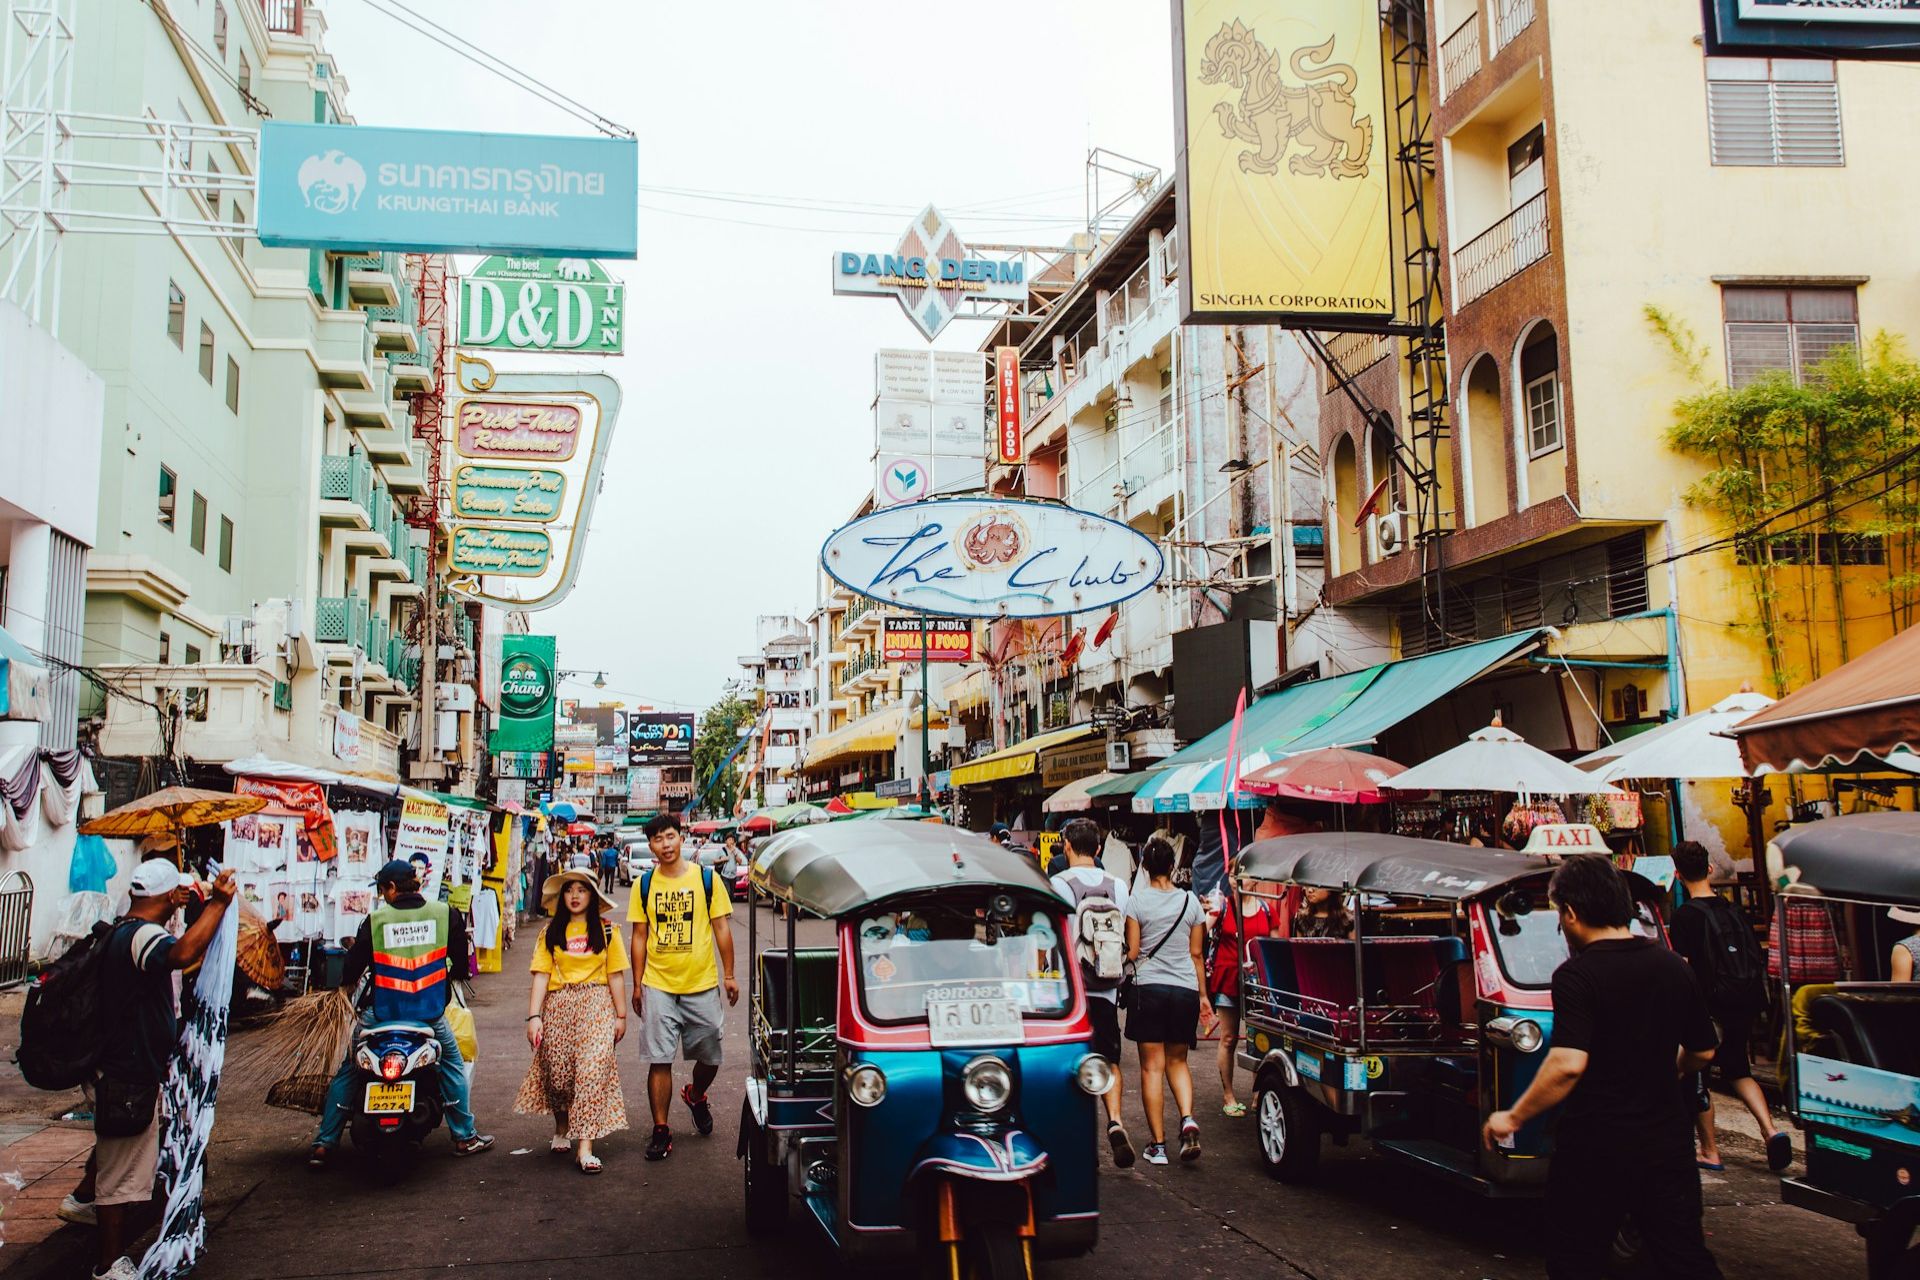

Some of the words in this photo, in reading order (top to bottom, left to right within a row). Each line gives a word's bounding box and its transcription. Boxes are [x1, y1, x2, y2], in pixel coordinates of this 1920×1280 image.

[378, 162, 605, 199] ธนาคารกรุงไทย
[377, 194, 498, 215] KRUNGTHAI
[504, 199, 559, 217] BANK
[506, 257, 521, 270] The
[522, 257, 540, 271] best
[841, 252, 926, 278] DANG
[941, 258, 1024, 283] DERM
[878, 275, 929, 288] Authentic
[934, 280, 956, 290] Thai
[959, 281, 988, 291] Hotel
[1200, 293, 1265, 306] SINGHA
[1269, 294, 1387, 310] CORPORATION
[464, 280, 593, 348] D&D
[601, 286, 619, 346] INN
[1004, 361, 1014, 413] INDIAN
[1006, 421, 1016, 457] FOOD
[862, 523, 966, 591] The
[1008, 547, 1141, 588] Club
[888, 621, 920, 631] TASTE
[937, 621, 966, 631] INDIA
[885, 633, 933, 649] INDIAN
[935, 633, 969, 649] FOOD
[501, 680, 546, 697] Chang
[402, 822, 421, 833] Your
[423, 825, 447, 837] Photo
[1543, 829, 1592, 846] TAXI
[671, 891, 684, 901] AM
[659, 902, 677, 912] ONE
[679, 900, 689, 912] OF
